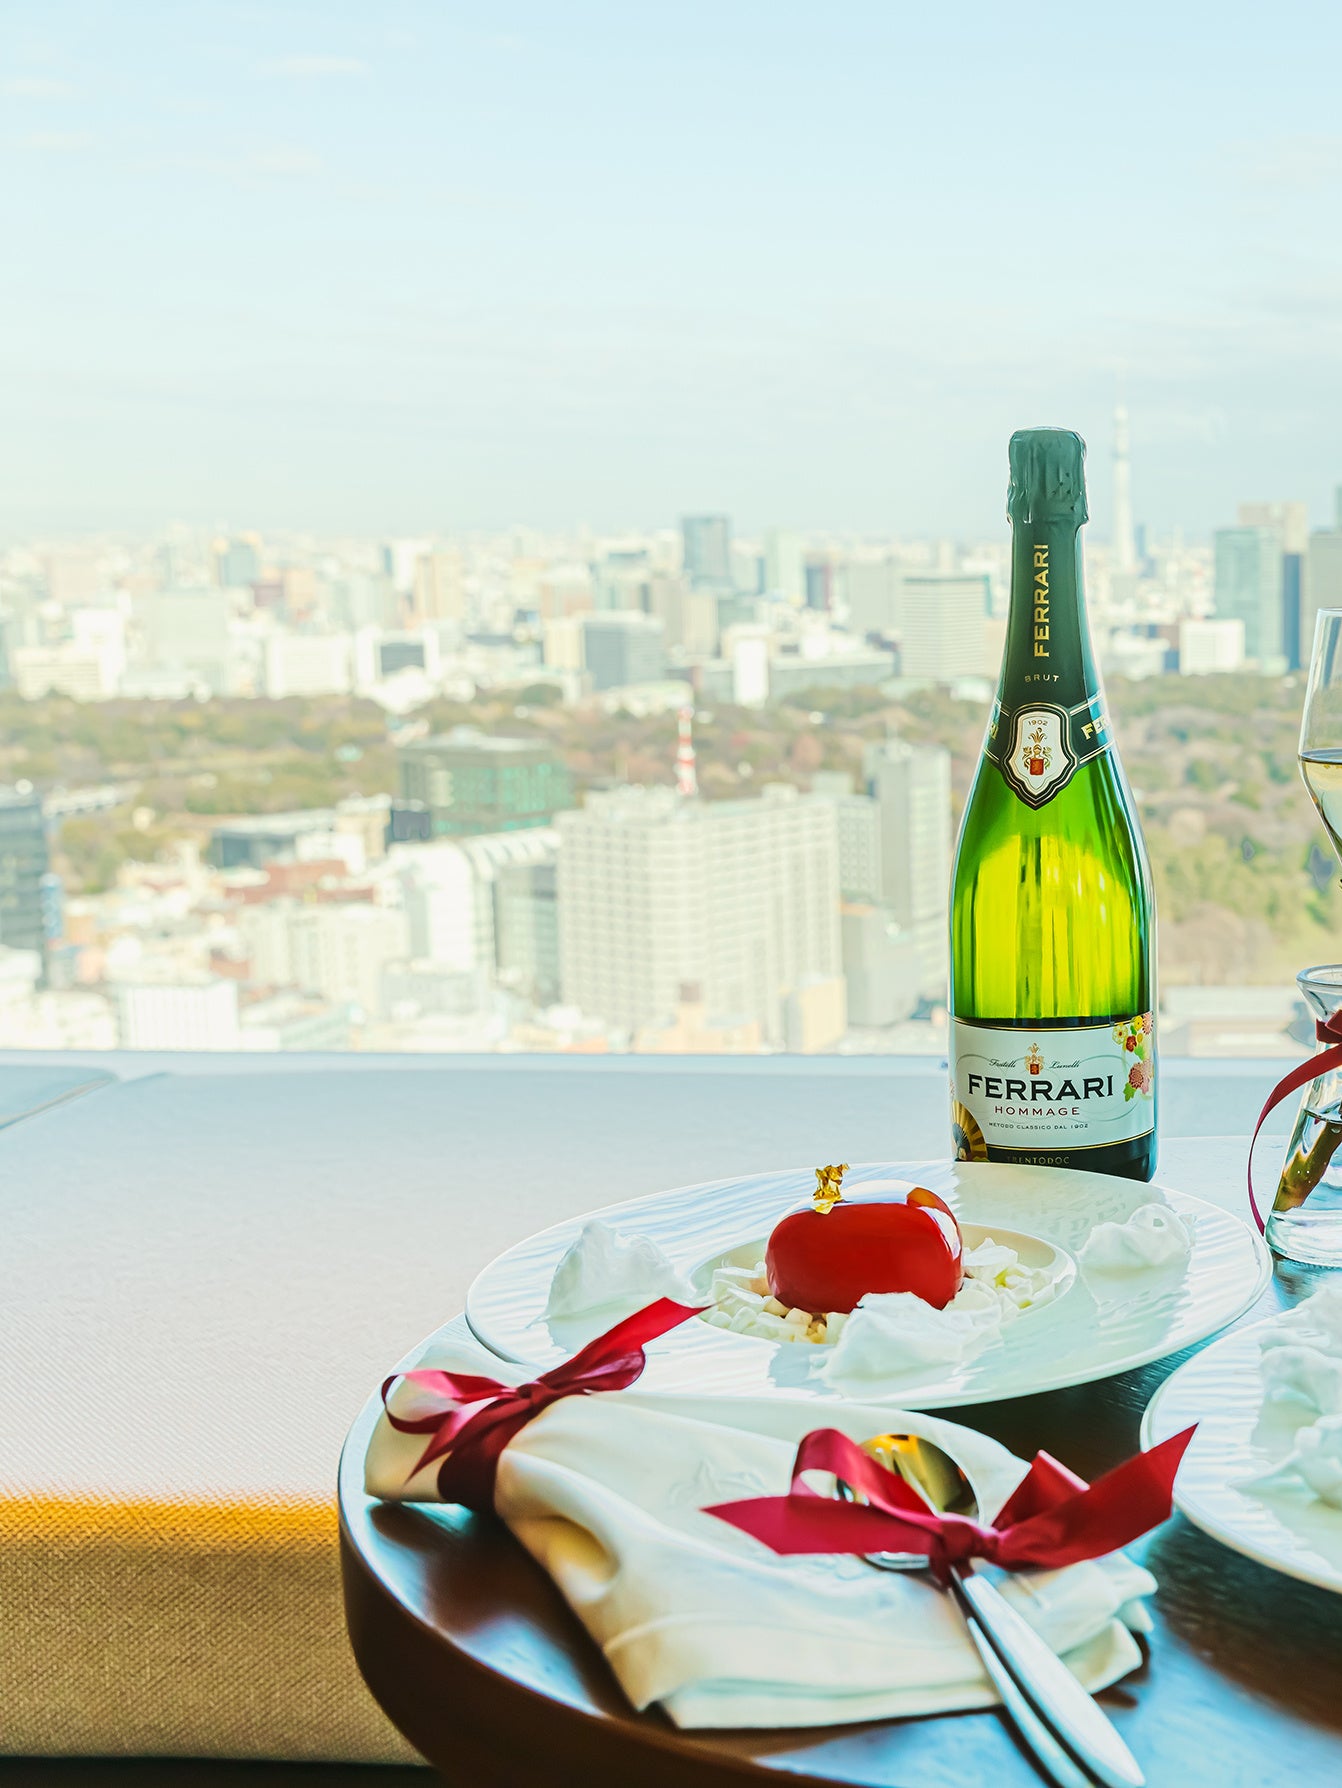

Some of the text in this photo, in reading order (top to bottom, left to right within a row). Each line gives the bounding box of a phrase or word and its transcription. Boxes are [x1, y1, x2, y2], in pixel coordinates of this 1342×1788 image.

[1034, 544, 1050, 657] FERRARI
[1024, 673, 1060, 682] BRUT
[968, 1073, 1114, 1101] FERRARI
[995, 1106, 1080, 1116] HOMMAGE
